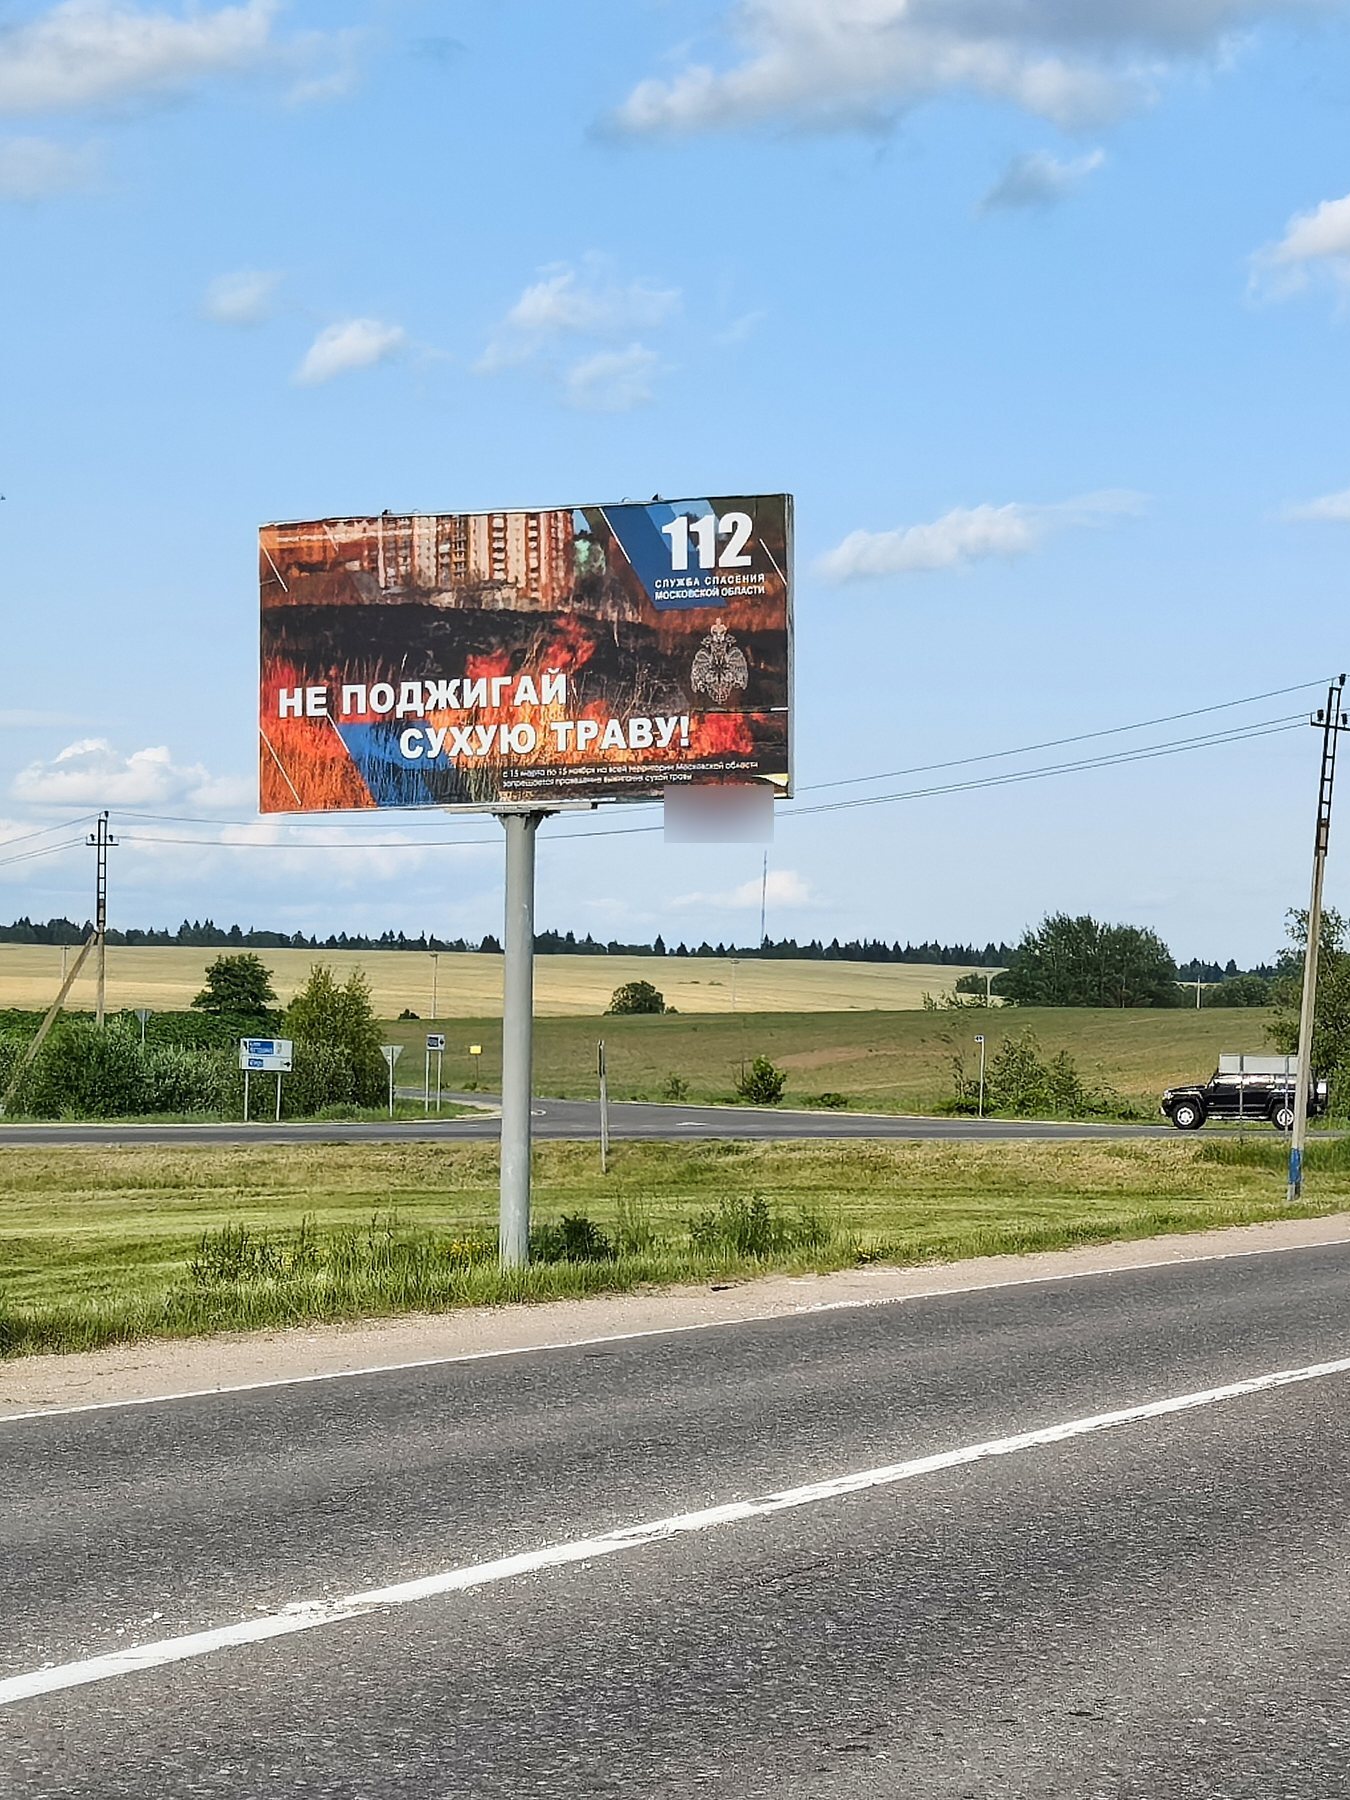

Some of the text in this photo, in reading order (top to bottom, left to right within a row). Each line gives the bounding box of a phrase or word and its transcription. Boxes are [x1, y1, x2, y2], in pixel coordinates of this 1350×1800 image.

[661, 511, 753, 571] 112
[655, 573, 765, 589] СЛУЖБА СПАСЕНИЯ
[655, 585, 766, 601] МОСКОВСКОЙ ОБЛАСТИ
[278, 667, 568, 718] НЕ ПОДЖИГАЙ
[400, 715, 691, 760] СУХУЮ ТРАВУ!
